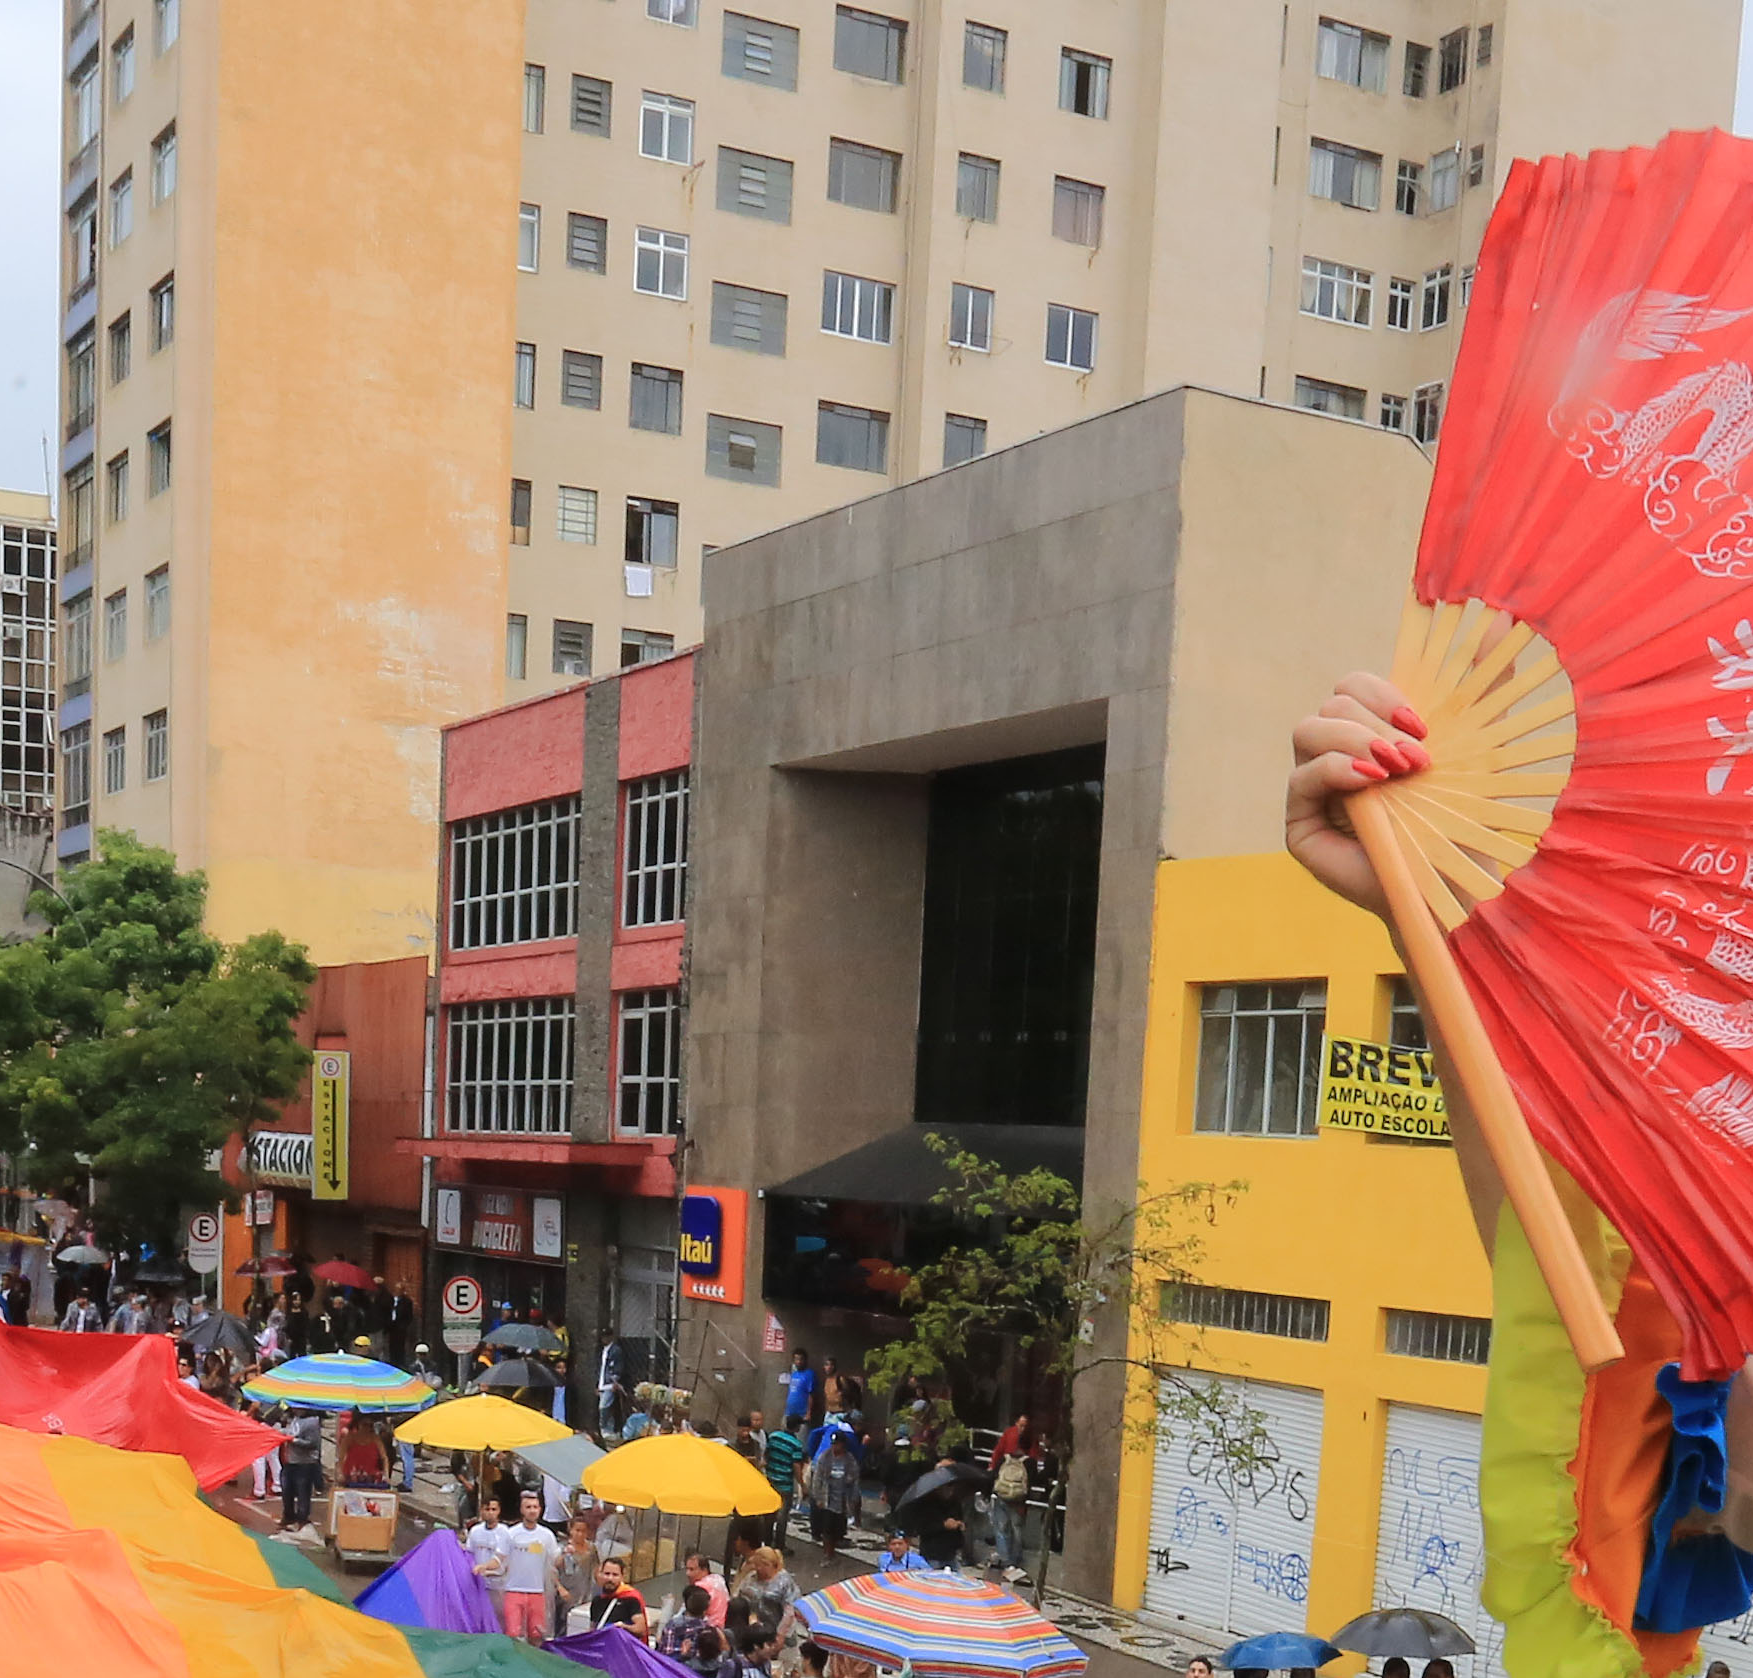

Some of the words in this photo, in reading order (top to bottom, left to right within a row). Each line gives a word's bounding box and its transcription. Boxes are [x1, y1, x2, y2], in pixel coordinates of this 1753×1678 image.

[1327, 1086, 1427, 1112] AMPLIAÇÃO
[1329, 1109, 1375, 1128] AUTO
[1381, 1114, 1451, 1136] ESCOLA
[199, 1219, 209, 1237] E
[680, 1233, 714, 1264] Itaú
[456, 1285, 469, 1306] E
